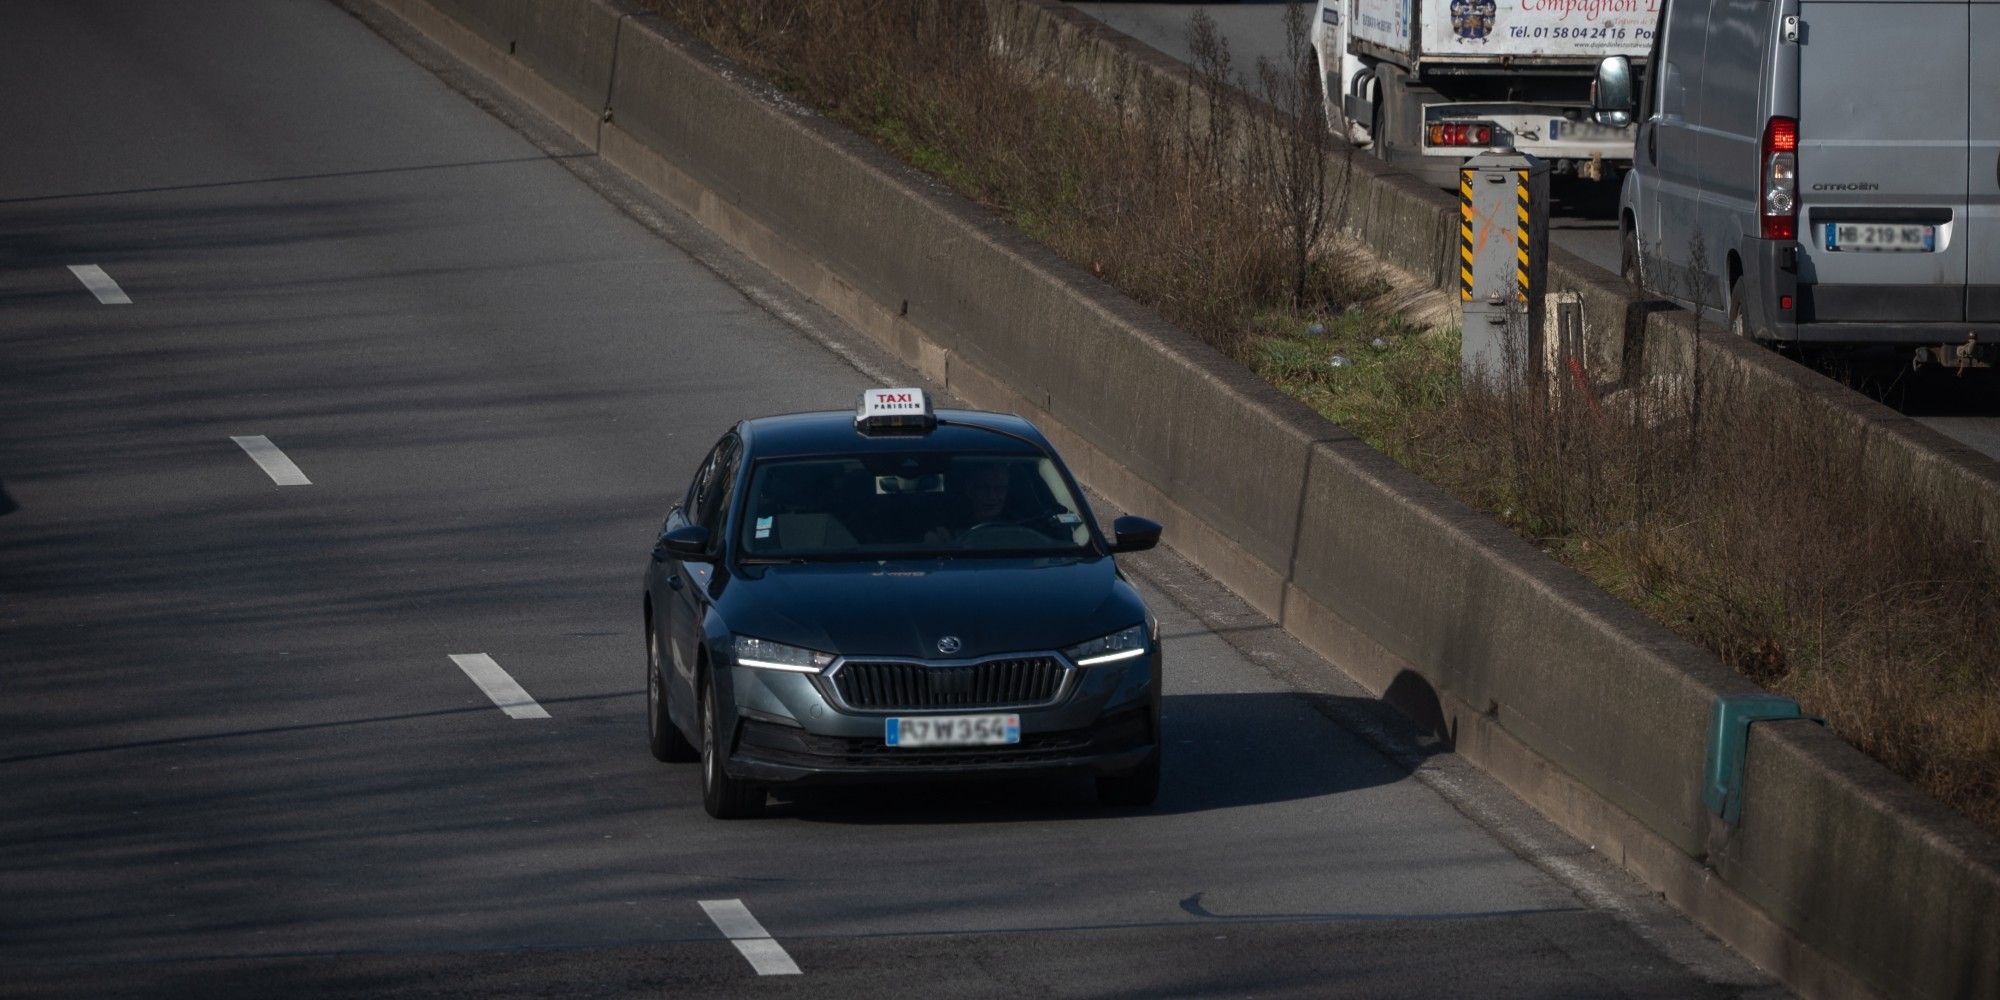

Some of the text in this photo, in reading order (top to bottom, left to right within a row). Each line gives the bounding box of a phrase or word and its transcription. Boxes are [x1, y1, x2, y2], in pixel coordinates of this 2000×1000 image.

[1520, 0, 1637, 21] Compagnon
[1510, 25, 1530, 38] Tél.
[1534, 26, 1549, 39] 01
[1552, 27, 1569, 39] 58
[1571, 27, 1588, 39] 04
[1590, 27, 1607, 39] 24
[1610, 28, 1626, 39] 16
[1812, 183, 1879, 191] CITROËN
[876, 393, 912, 403] TAXI
